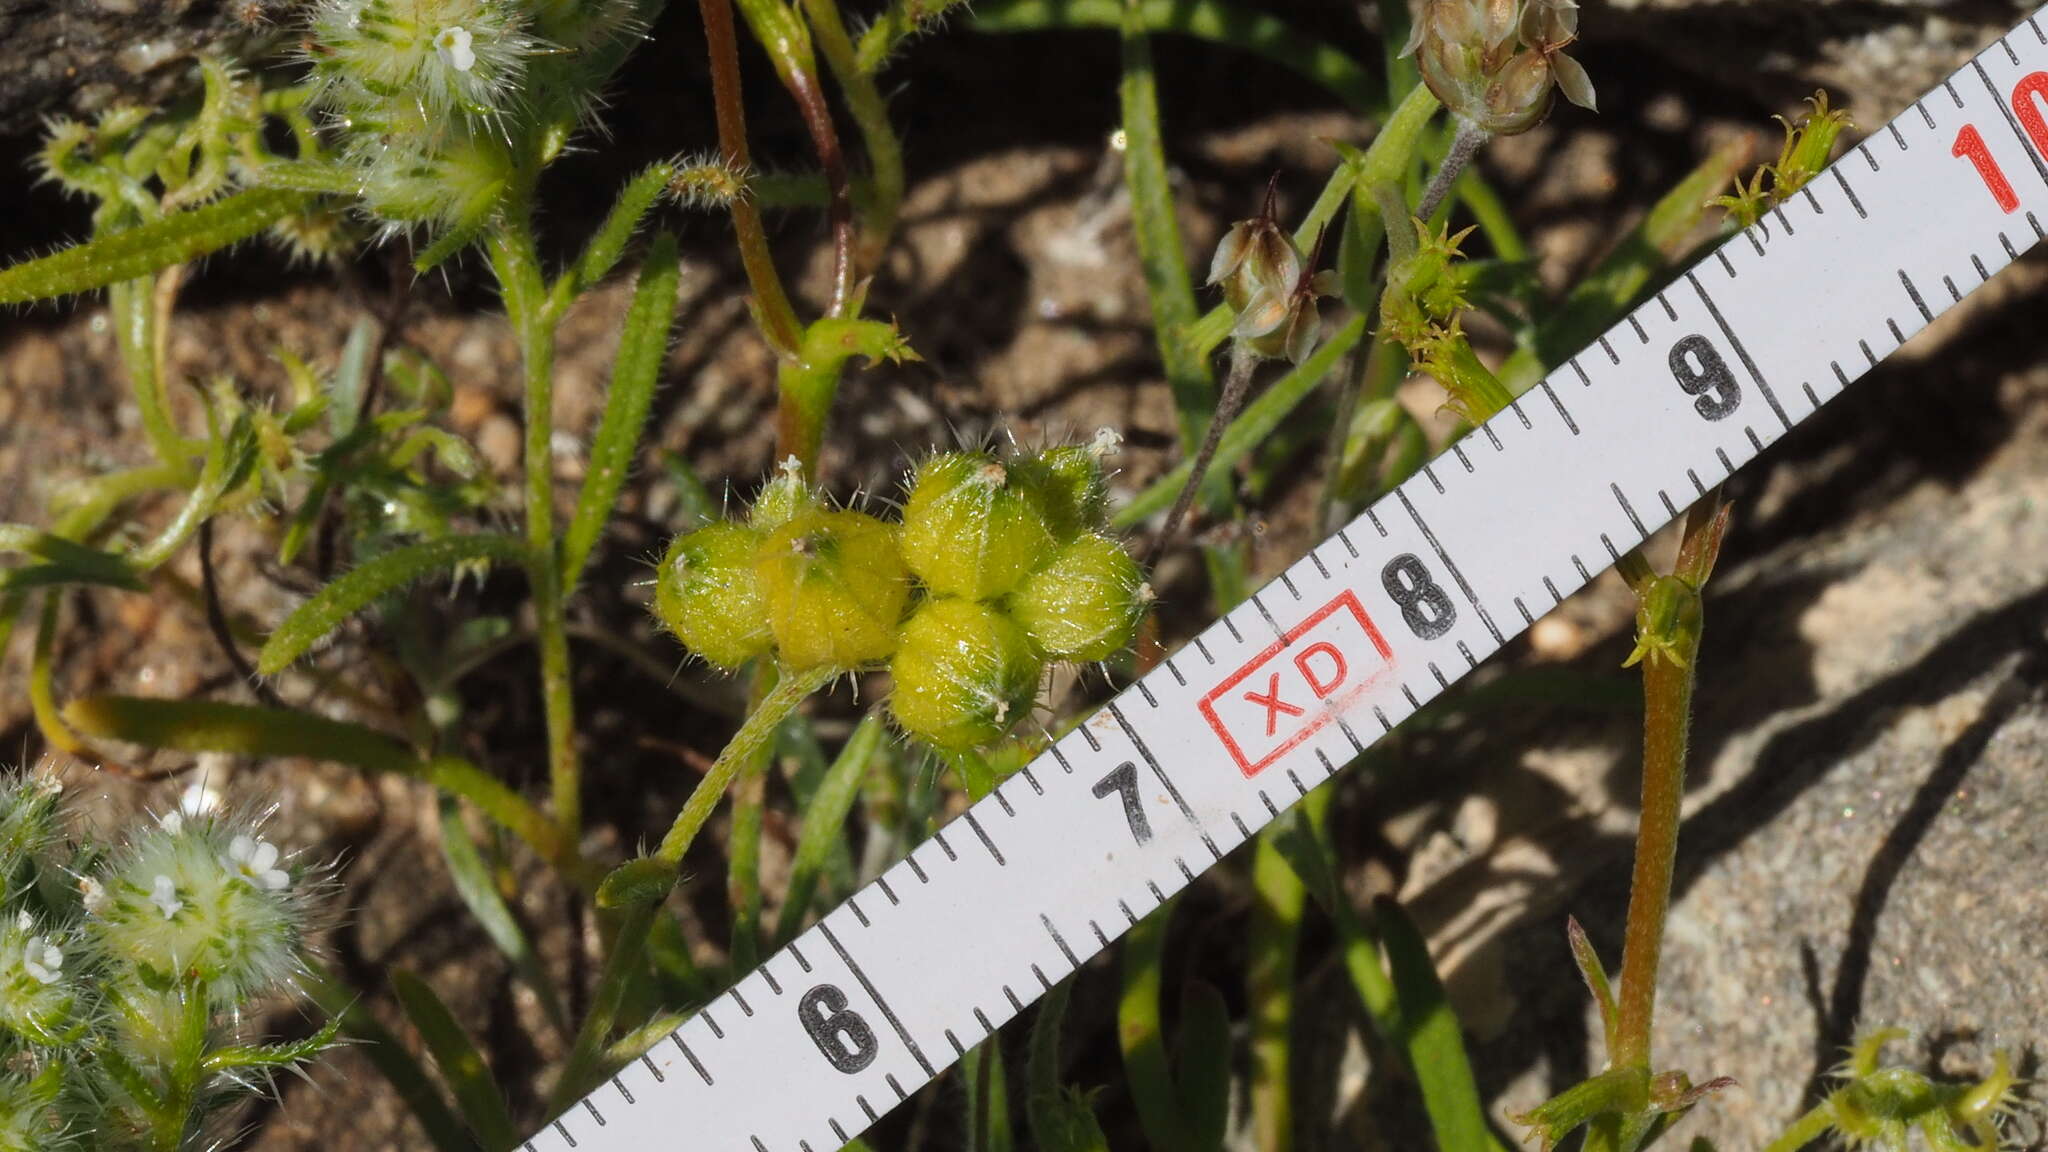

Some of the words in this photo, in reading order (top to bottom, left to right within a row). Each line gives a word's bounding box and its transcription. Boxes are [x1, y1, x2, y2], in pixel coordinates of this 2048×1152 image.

[799, 984, 878, 1074] 6
[1092, 761, 1153, 848] 7
[1244, 642, 1348, 737] XD
[1381, 553, 1457, 640] 8
[1669, 334, 1742, 422] 9
